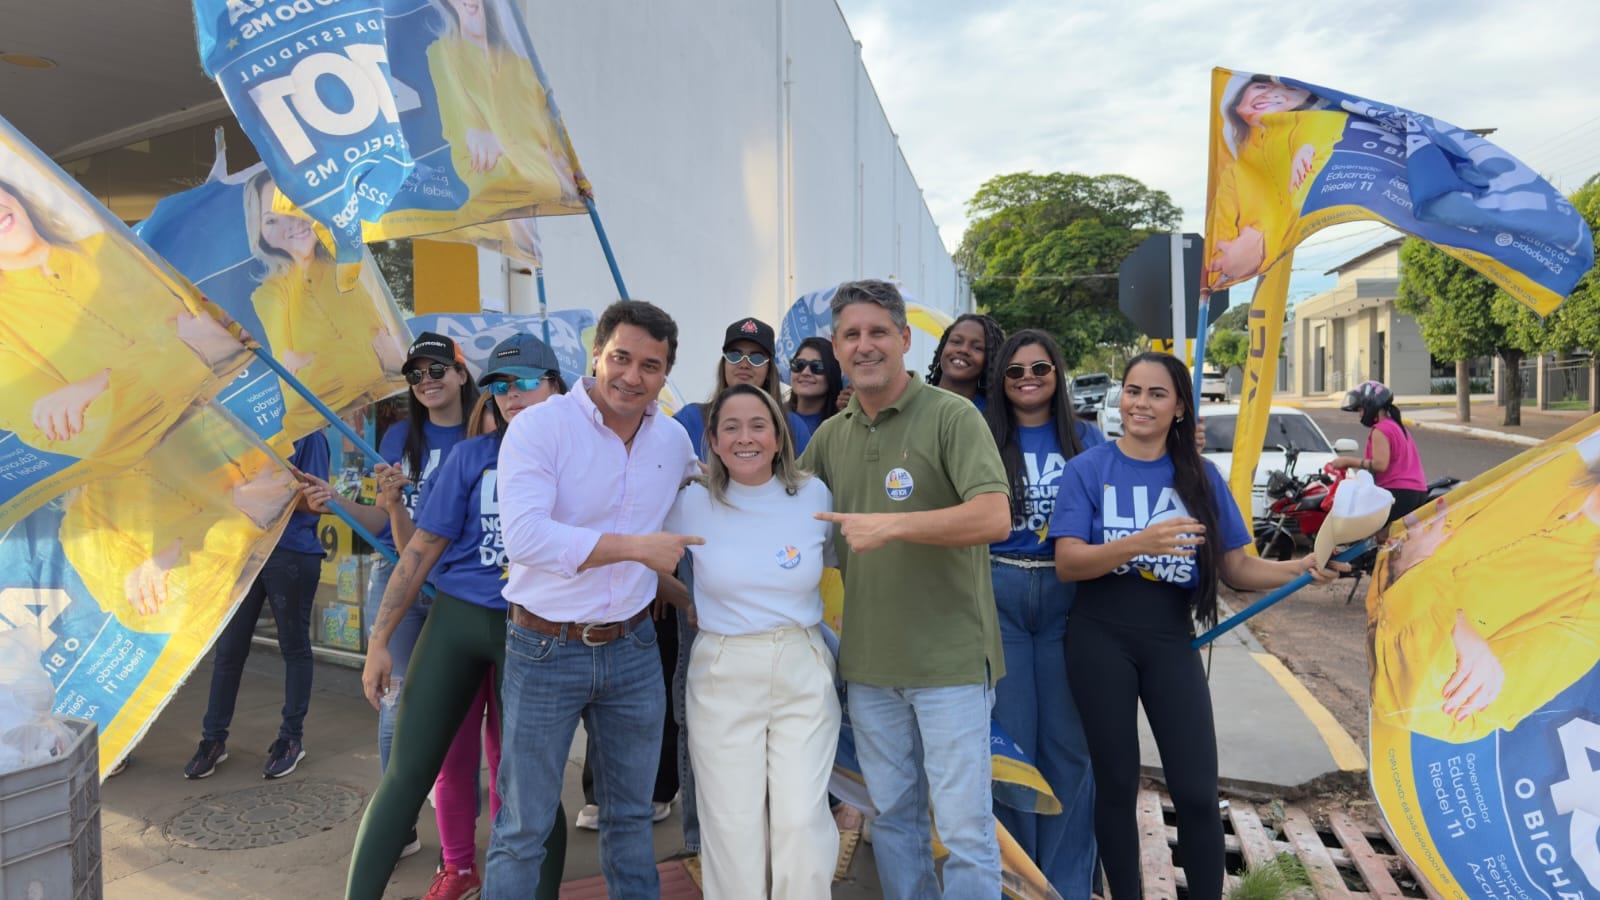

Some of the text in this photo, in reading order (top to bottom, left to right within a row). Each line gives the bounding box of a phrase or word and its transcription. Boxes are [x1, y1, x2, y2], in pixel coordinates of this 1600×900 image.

[1321, 180, 1374, 194] Riedel 11
[1326, 171, 1377, 182] Eduardo
[1103, 485, 1191, 529] LIA
[1153, 563, 1192, 583] MS
[1428, 762, 1465, 838] Riedel 11
[1447, 756, 1476, 829] Eduardo
[1466, 753, 1491, 824] Governador
[1515, 778, 1535, 799] O
